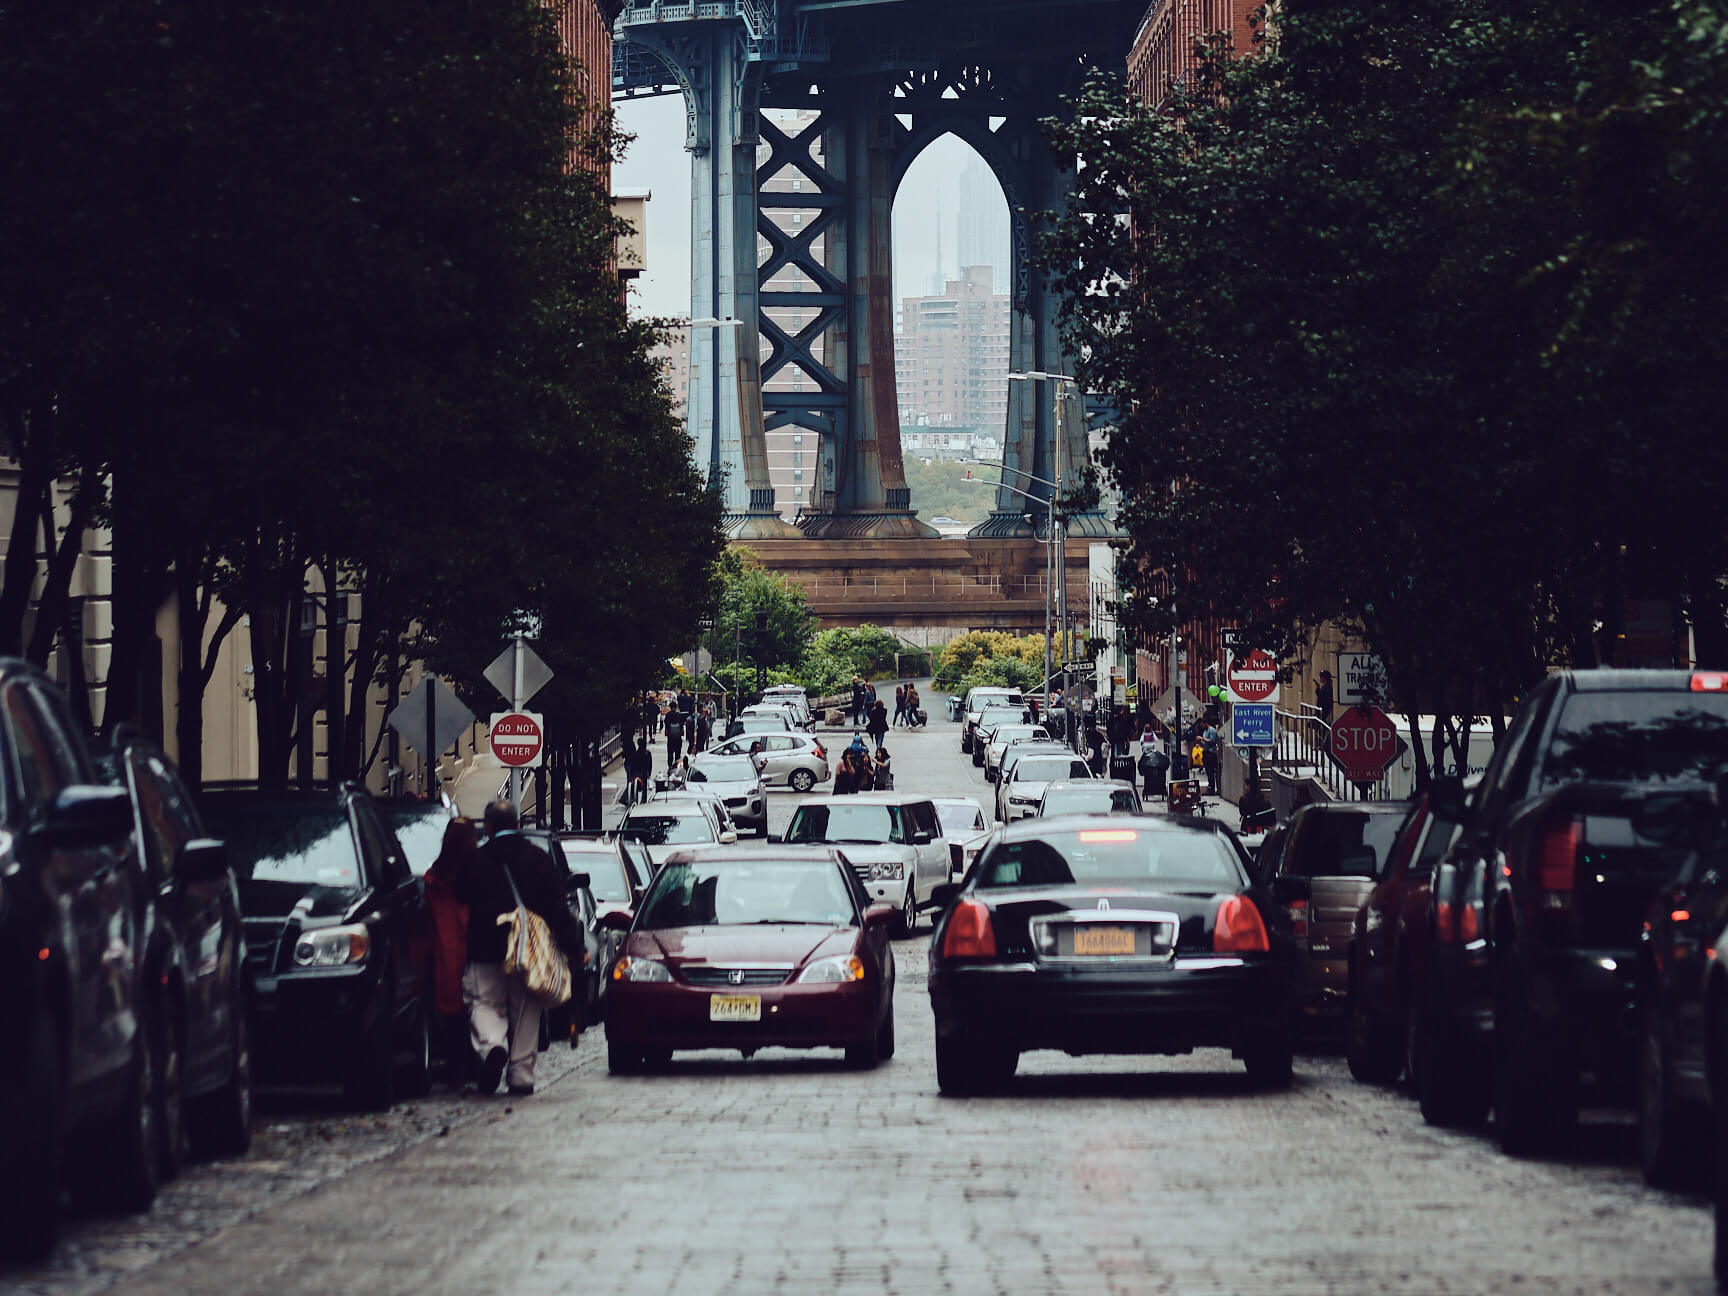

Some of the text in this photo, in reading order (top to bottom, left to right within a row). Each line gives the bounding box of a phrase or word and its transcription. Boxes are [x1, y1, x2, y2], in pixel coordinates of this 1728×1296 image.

[1238, 682, 1268, 692] ENTER
[1234, 708, 1272, 716] East River
[1243, 719, 1263, 728] Ferry
[498, 724, 535, 733] DO NOT
[1336, 727, 1392, 751] STOP
[501, 747, 530, 756] ENTER
